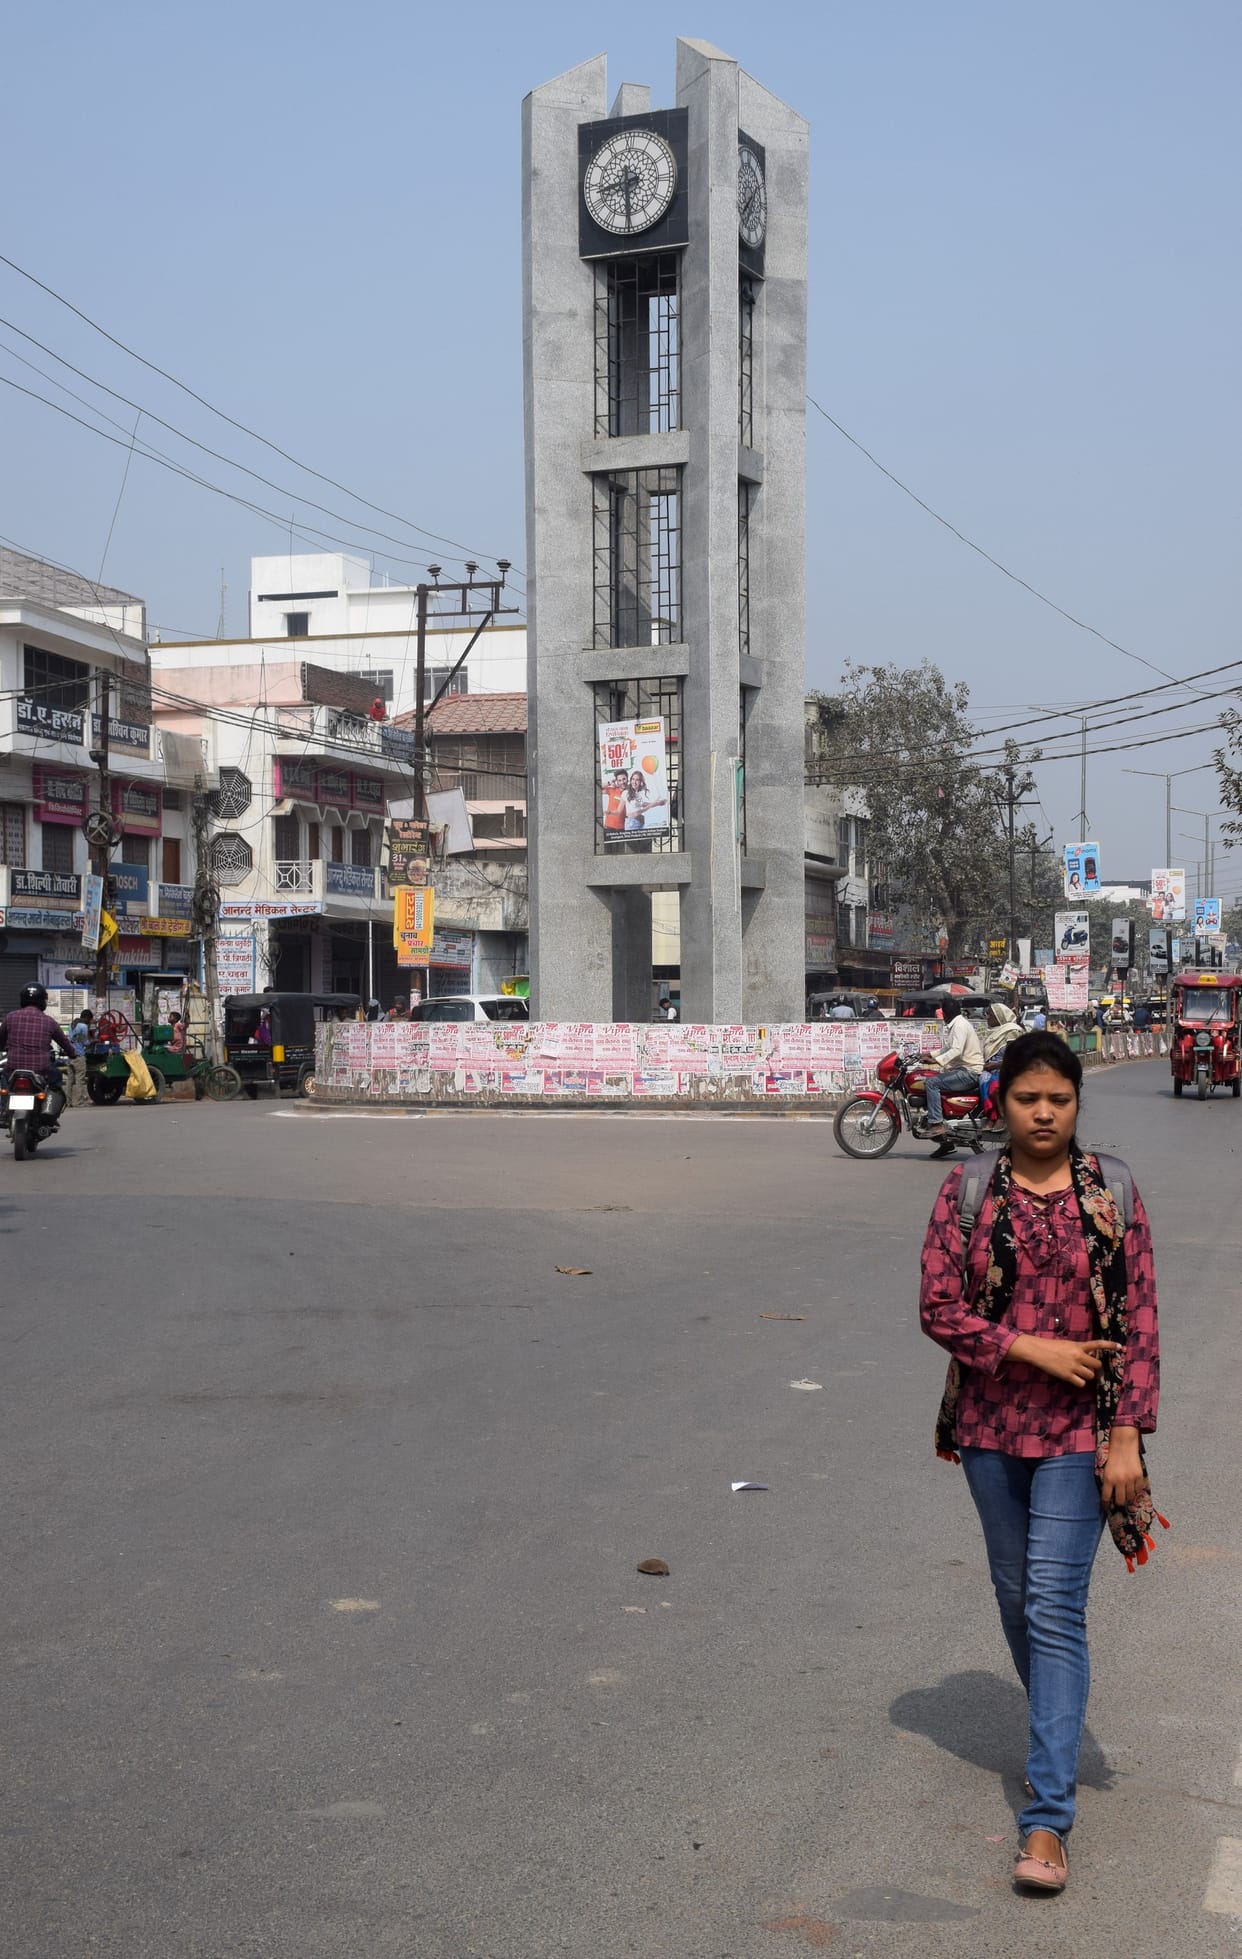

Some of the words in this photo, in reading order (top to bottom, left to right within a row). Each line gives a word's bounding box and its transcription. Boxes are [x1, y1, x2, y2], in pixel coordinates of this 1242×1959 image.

[608, 742, 629, 759] 50%
[611, 759, 624, 768] OFF
[222, 906, 251, 916] आनन्द
[255, 904, 287, 915] मेडिकल
[894, 961, 920, 973] विशाल
[602, 1025, 631, 1036] Vipra
